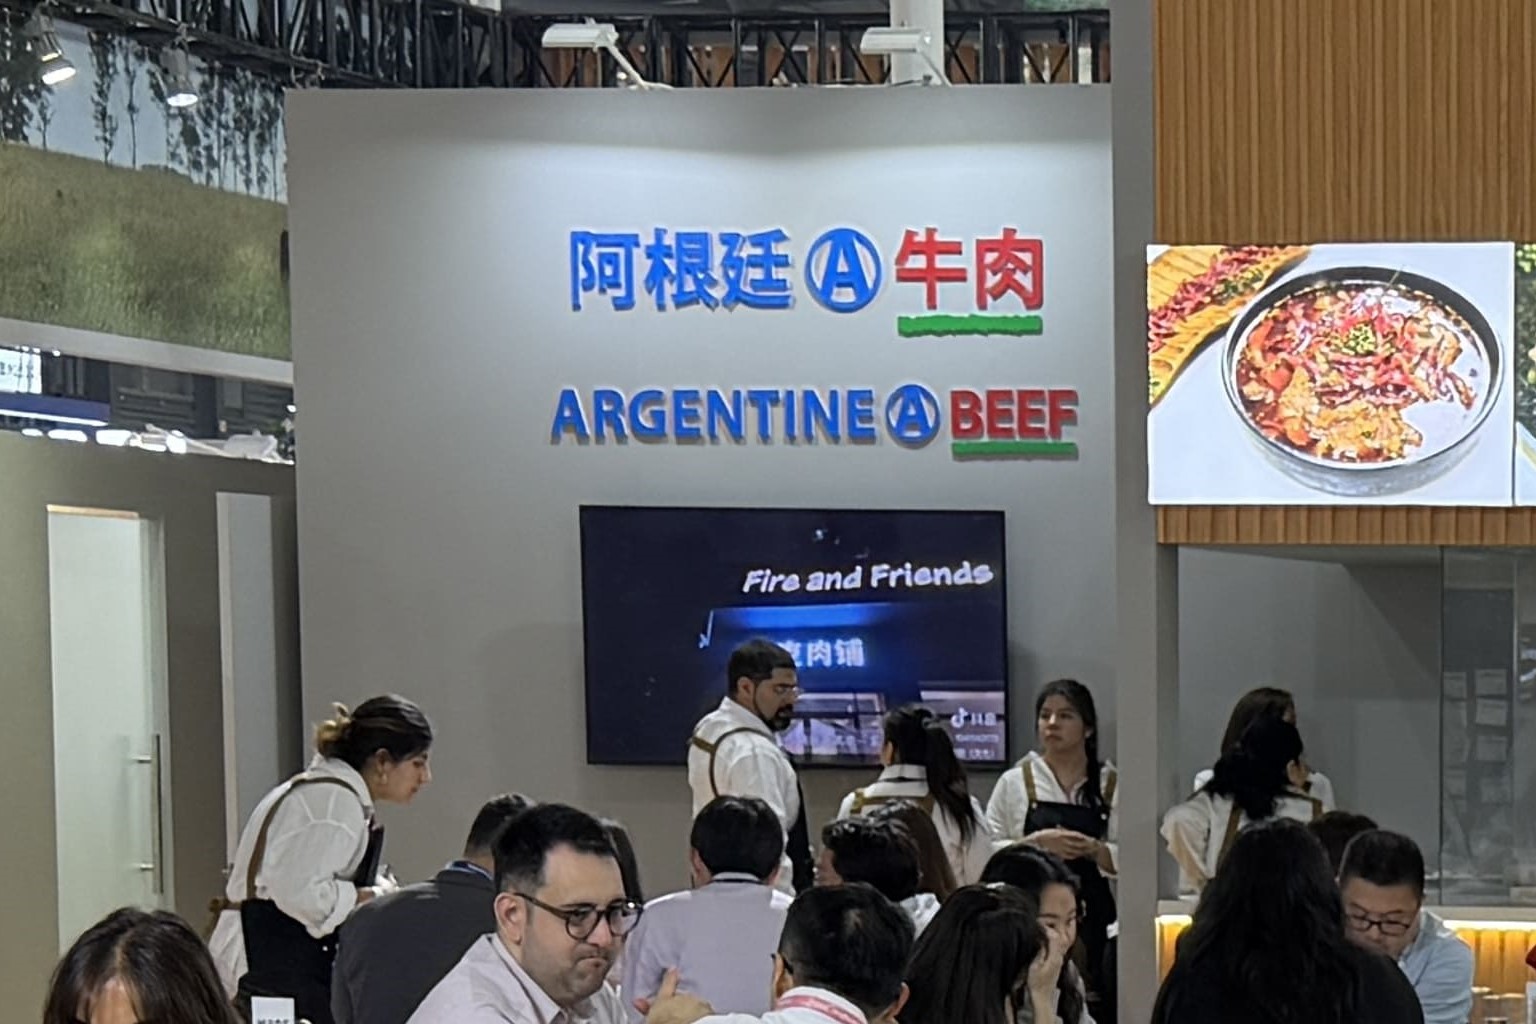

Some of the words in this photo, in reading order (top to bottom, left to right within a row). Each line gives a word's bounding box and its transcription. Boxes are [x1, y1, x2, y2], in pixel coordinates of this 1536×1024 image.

[570, 228, 791, 311] 阿根廷
[895, 228, 1043, 309] 牛肉
[551, 389, 876, 440] ARGENTINE
[950, 390, 1077, 438] BEEF
[742, 568, 800, 592] Fire
[805, 565, 862, 591] and
[870, 561, 994, 588] Friends
